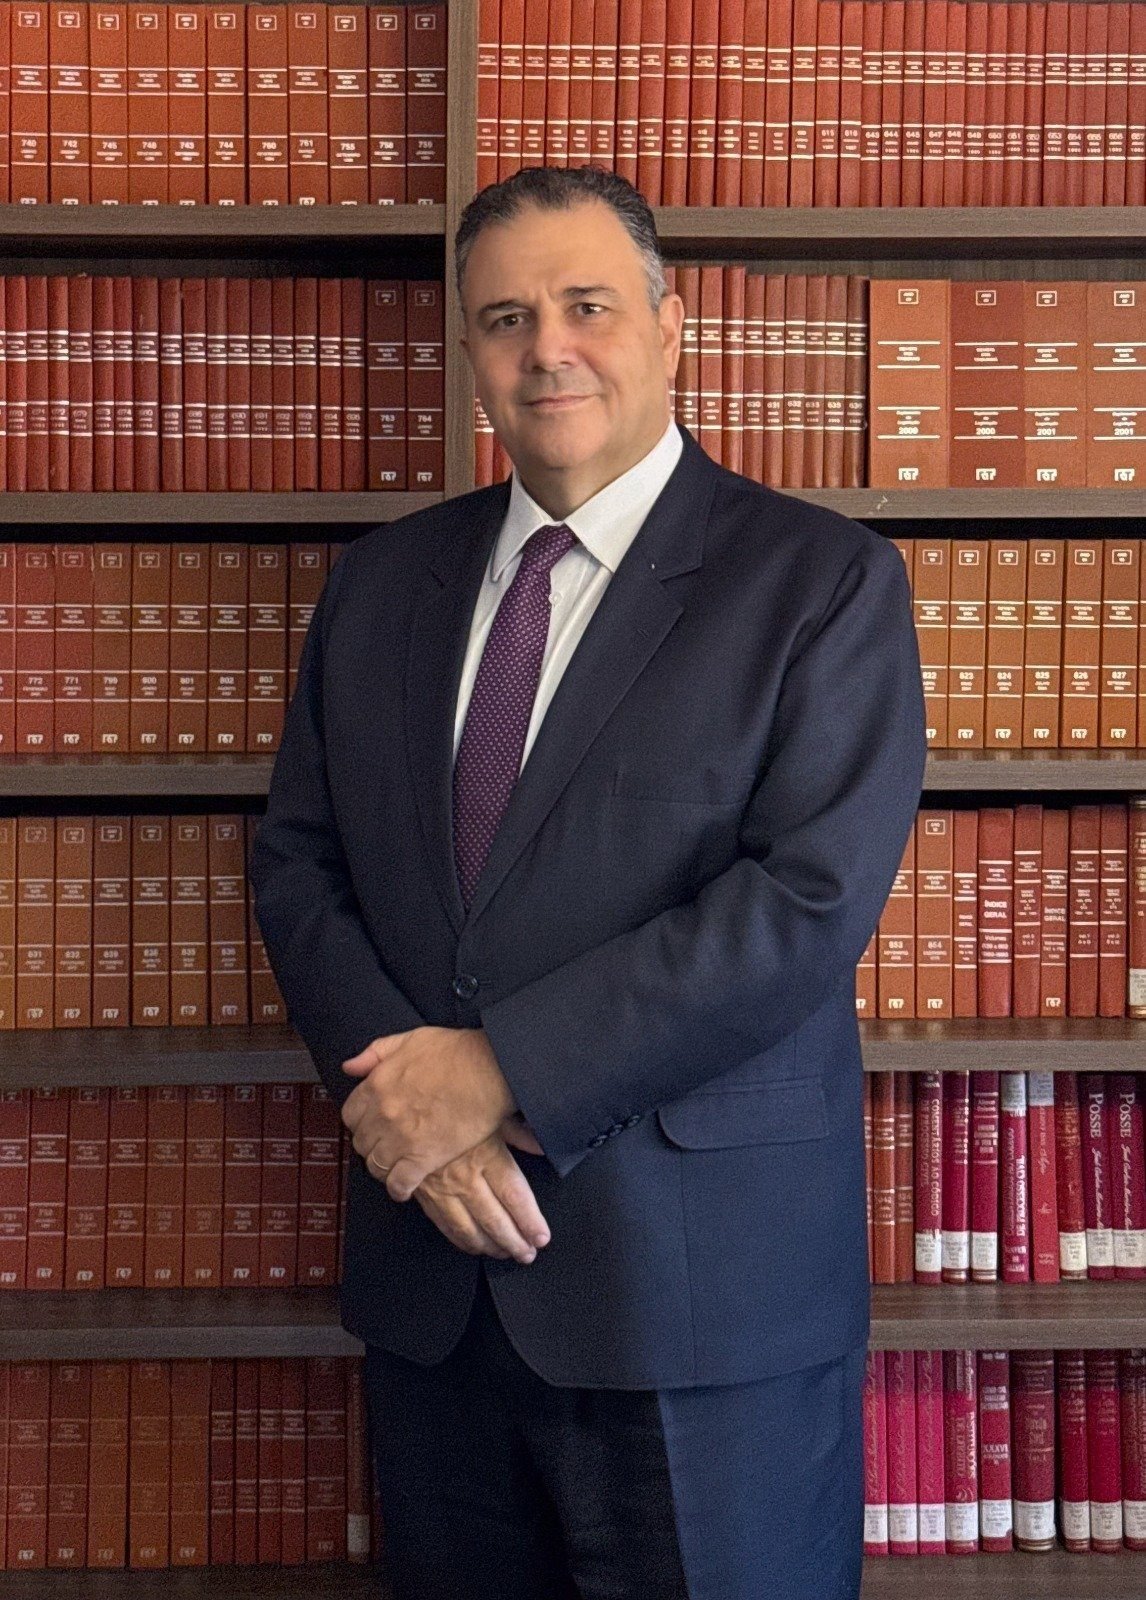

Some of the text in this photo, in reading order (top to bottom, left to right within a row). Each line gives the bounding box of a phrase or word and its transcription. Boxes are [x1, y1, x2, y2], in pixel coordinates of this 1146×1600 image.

[898, 426, 918, 435] 2000
[976, 427, 996, 435] 2000
[28, 676, 44, 684] 772
[984, 900, 1008, 908] ÍNDICE
[1088, 1092, 1103, 1138] POSSE
[1119, 1092, 1134, 1138] POSSE
[1016, 1155, 1025, 1179] CIVIL
[1016, 1180, 1025, 1222] PROCESSO
